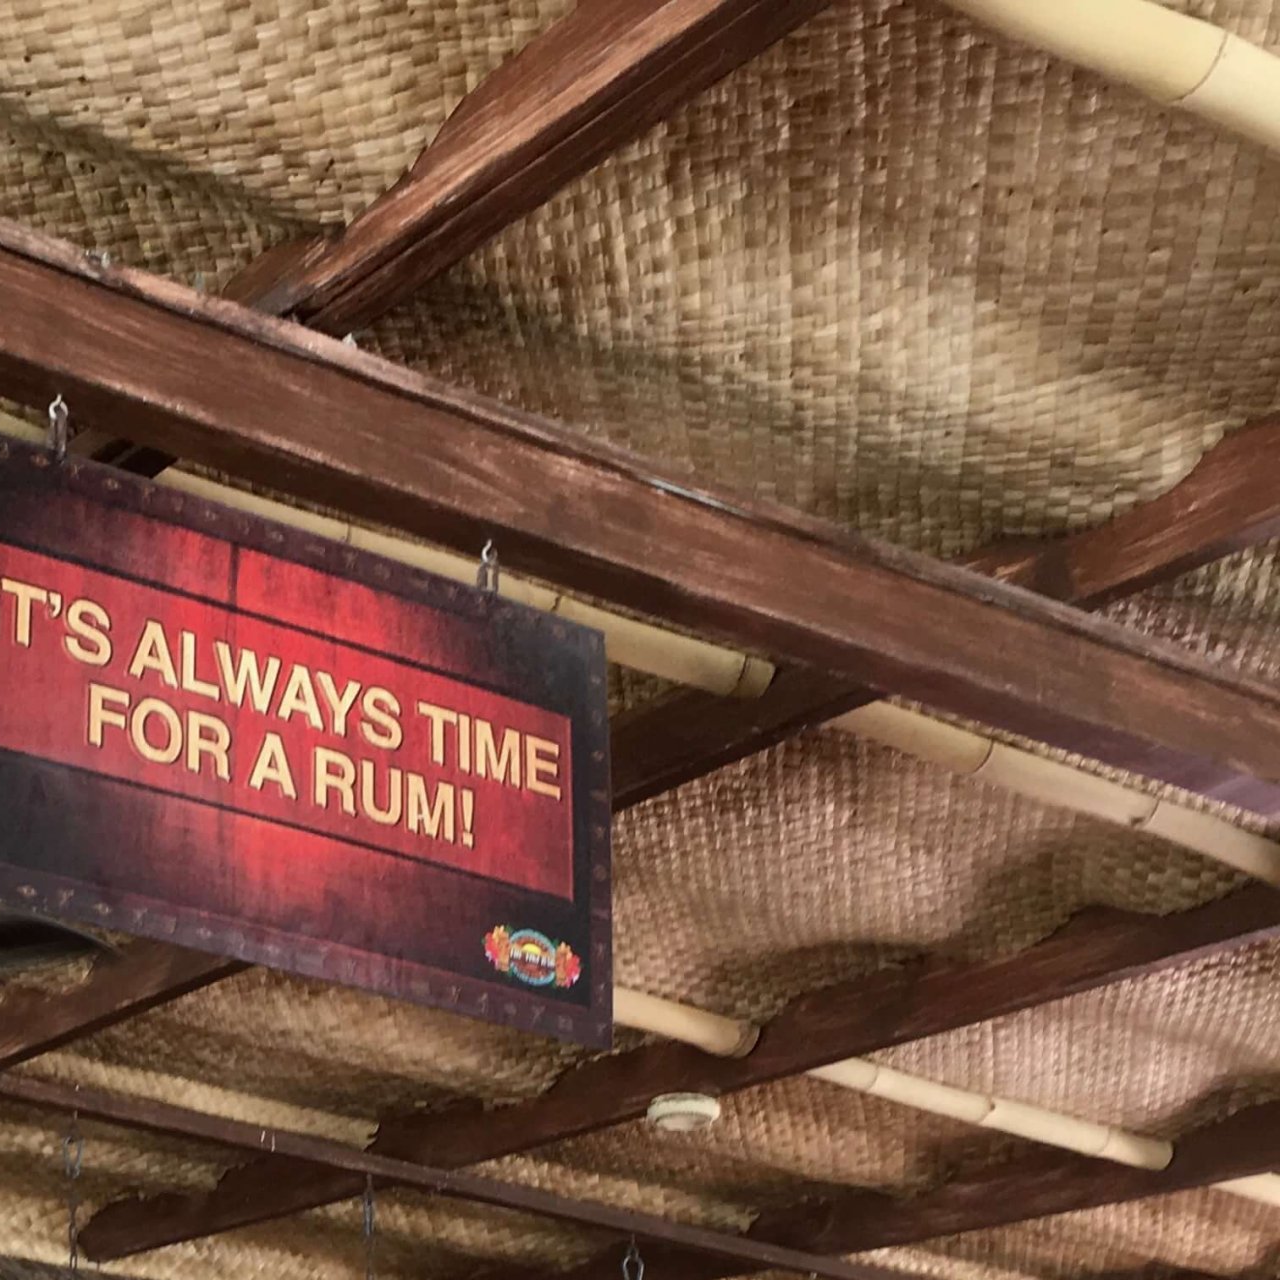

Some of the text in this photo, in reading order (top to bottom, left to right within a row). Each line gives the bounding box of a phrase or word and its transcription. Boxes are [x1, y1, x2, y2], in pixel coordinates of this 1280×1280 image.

[86, 682, 476, 848] FOR A RUM!
[128, 622, 403, 750] ALWAYS
[416, 700, 563, 800] TIME
